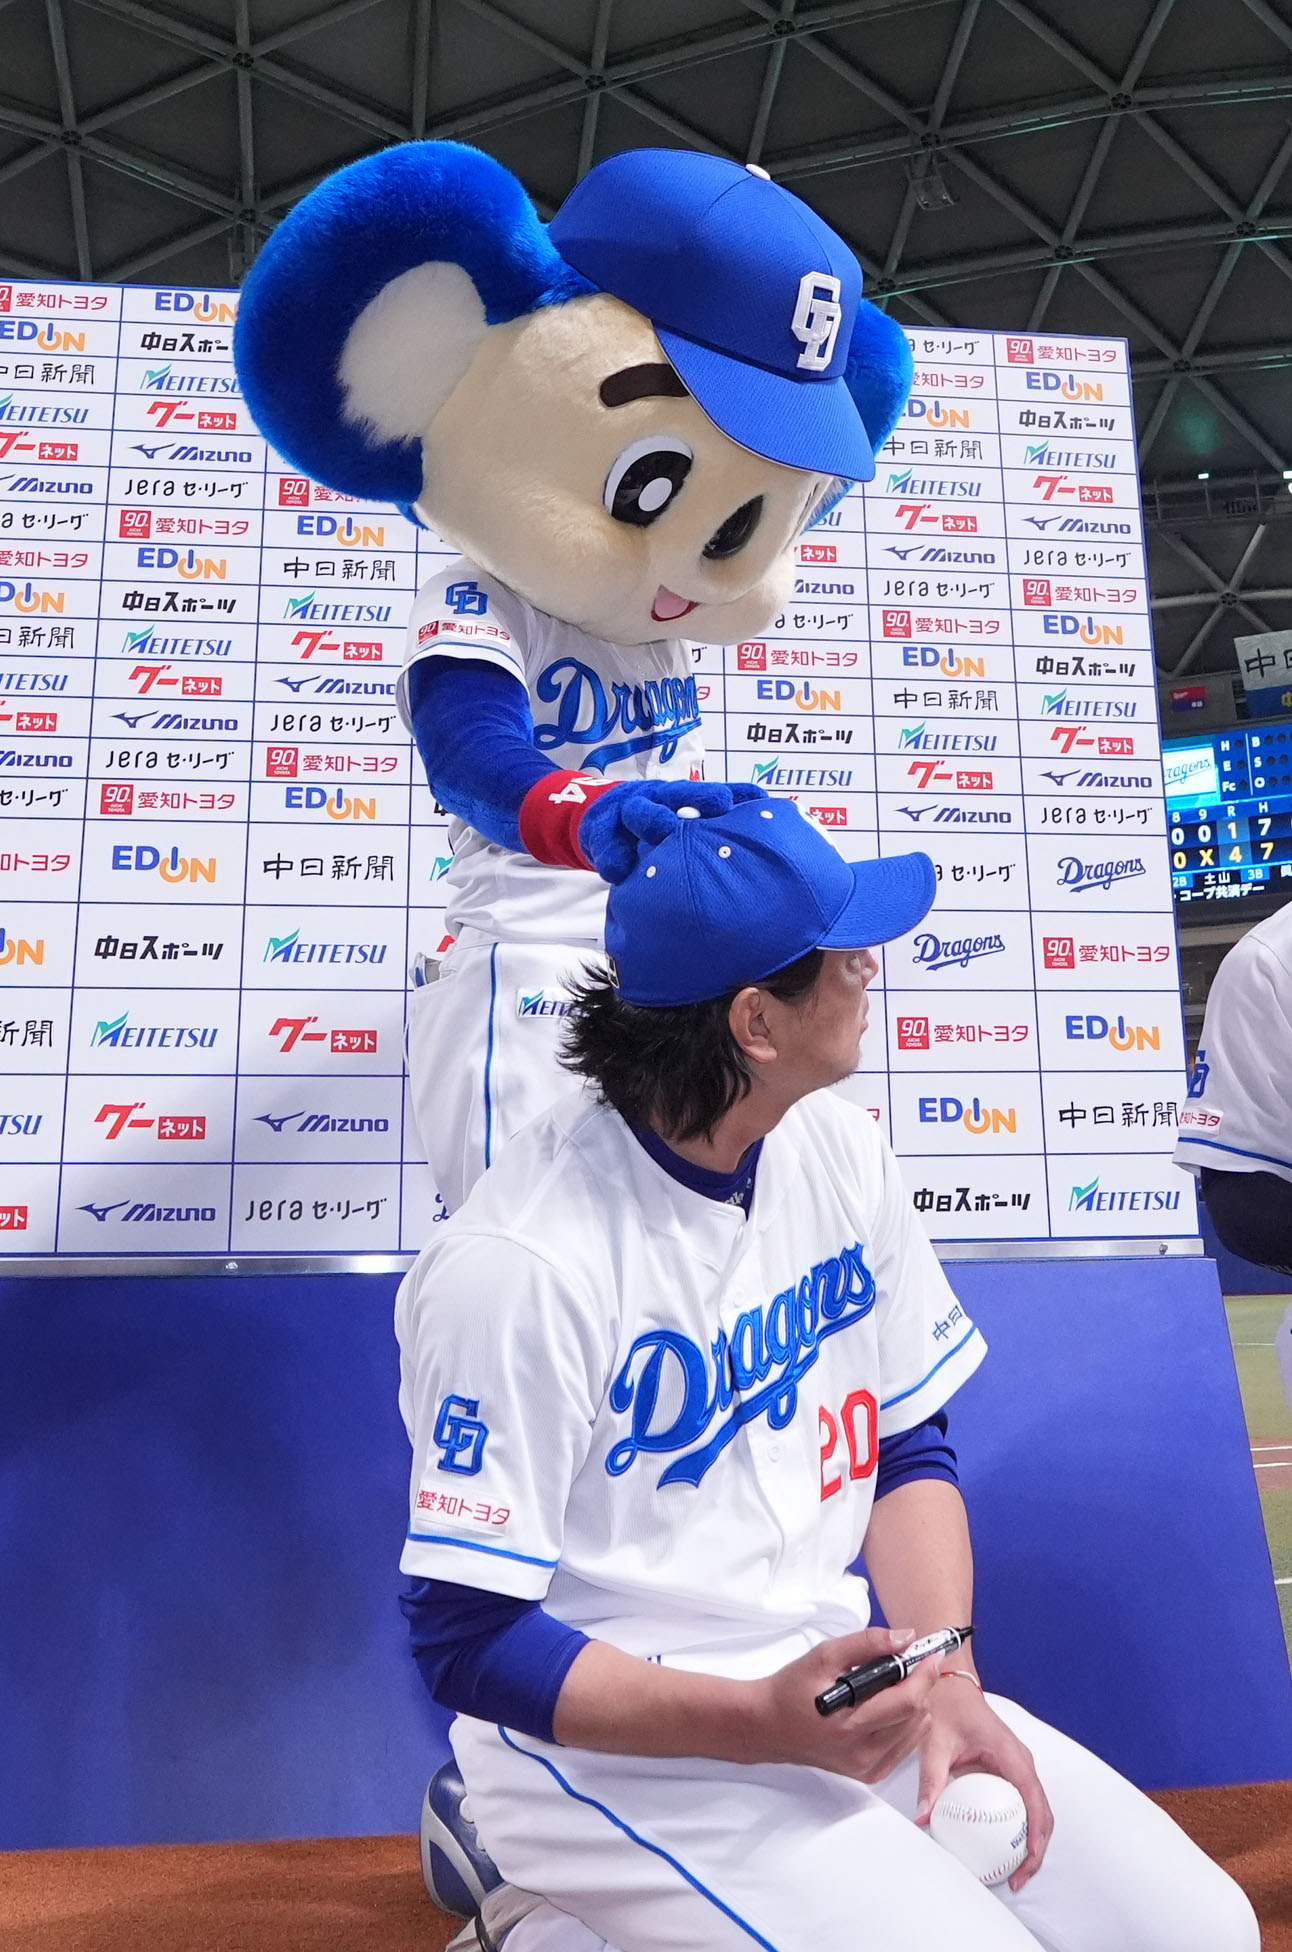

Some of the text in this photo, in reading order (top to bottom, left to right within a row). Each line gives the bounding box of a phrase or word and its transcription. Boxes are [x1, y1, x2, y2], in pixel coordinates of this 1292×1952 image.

[16, 293, 107, 310] 愛知トヨタ
[155, 292, 235, 322] EDION
[0, 320, 85, 351] EDION
[141, 332, 228, 352] 中日スポー
[1009, 340, 1032, 354] 90
[1038, 346, 1116, 362] 愛知トヨタ
[1026, 372, 1103, 401] EDION
[897, 396, 969, 428] DION
[1019, 410, 1115, 431] 中日スポーツ
[883, 436, 983, 460] 中日新聞
[1024, 441, 1116, 468] MEITETSU
[283, 481, 307, 495] 90
[887, 469, 981, 496] MEITETSU
[122, 512, 149, 528] 90
[156, 518, 248, 535] 愛知トヨタ
[297, 515, 384, 546] EDION
[0, 551, 88, 568] 愛知トヨタ
[138, 547, 226, 579] EDION
[284, 556, 395, 581] 中日新聞
[0, 581, 64, 613] DION
[122, 591, 236, 613] 中日スポーツ
[1026, 581, 1050, 595] 90
[1055, 587, 1136, 603] 愛知トヨタ
[284, 592, 391, 621] MEITETSU
[885, 612, 909, 627] 90
[916, 618, 999, 634] 愛知トヨタ
[1043, 615, 1123, 645] EDION
[0, 626, 74, 649] 日新聞
[122, 625, 232, 656] MEITETSU
[739, 645, 764, 660] 90
[771, 650, 857, 666] 愛知トヨタ
[903, 647, 984, 677] EDION
[1036, 656, 1135, 677] 中日スポーツ
[757, 680, 840, 710] EDION
[894, 688, 998, 711] 中日新聞
[1041, 689, 1136, 717] MEITETSU
[747, 723, 853, 744] 中日スポーツ
[898, 722, 997, 751] MEITETSU
[1221, 736, 1260, 752] H B
[268, 750, 398, 772] 90 愛知トヨタ
[751, 756, 853, 787] MEITETSU
[1163, 759, 1212, 785] ragons
[1223, 756, 1262, 772] E S
[104, 786, 235, 809] 90 愛知トヨタ
[285, 787, 376, 819] EDION
[1172, 801, 1269, 823] 8 9 R H
[1171, 817, 1272, 846] 0 0 1 7
[0, 853, 70, 871] トヨタ
[112, 845, 216, 883] EDION
[263, 853, 394, 881] 中日新聞
[1173, 841, 1274, 869] 0 X 4 7
[1057, 857, 1146, 893] Dragons
[1204, 872, 1231, 885] 土山
[1247, 868, 1264, 880] 3B
[94, 935, 223, 960] 中日スポーツ
[263, 929, 387, 963] MEITETSU
[912, 934, 1005, 971] Dragons
[1044, 939, 1169, 962] 90 愛知トヨタ
[90, 1012, 218, 1047] MEITETSU
[900, 1019, 1028, 1042] 90 愛知トヨタ
[1066, 1016, 1160, 1051] EDION
[919, 1097, 1016, 1134] EDION
[1059, 1101, 1179, 1128] 中日新聞
[913, 1188, 1030, 1212] 中日スポーツ
[1069, 1177, 1180, 1211] MEITETSU
[605, 1241, 877, 1491] Dragons
[819, 1389, 880, 1502] 20
[417, 1489, 511, 1526] 愛知トヨタ
